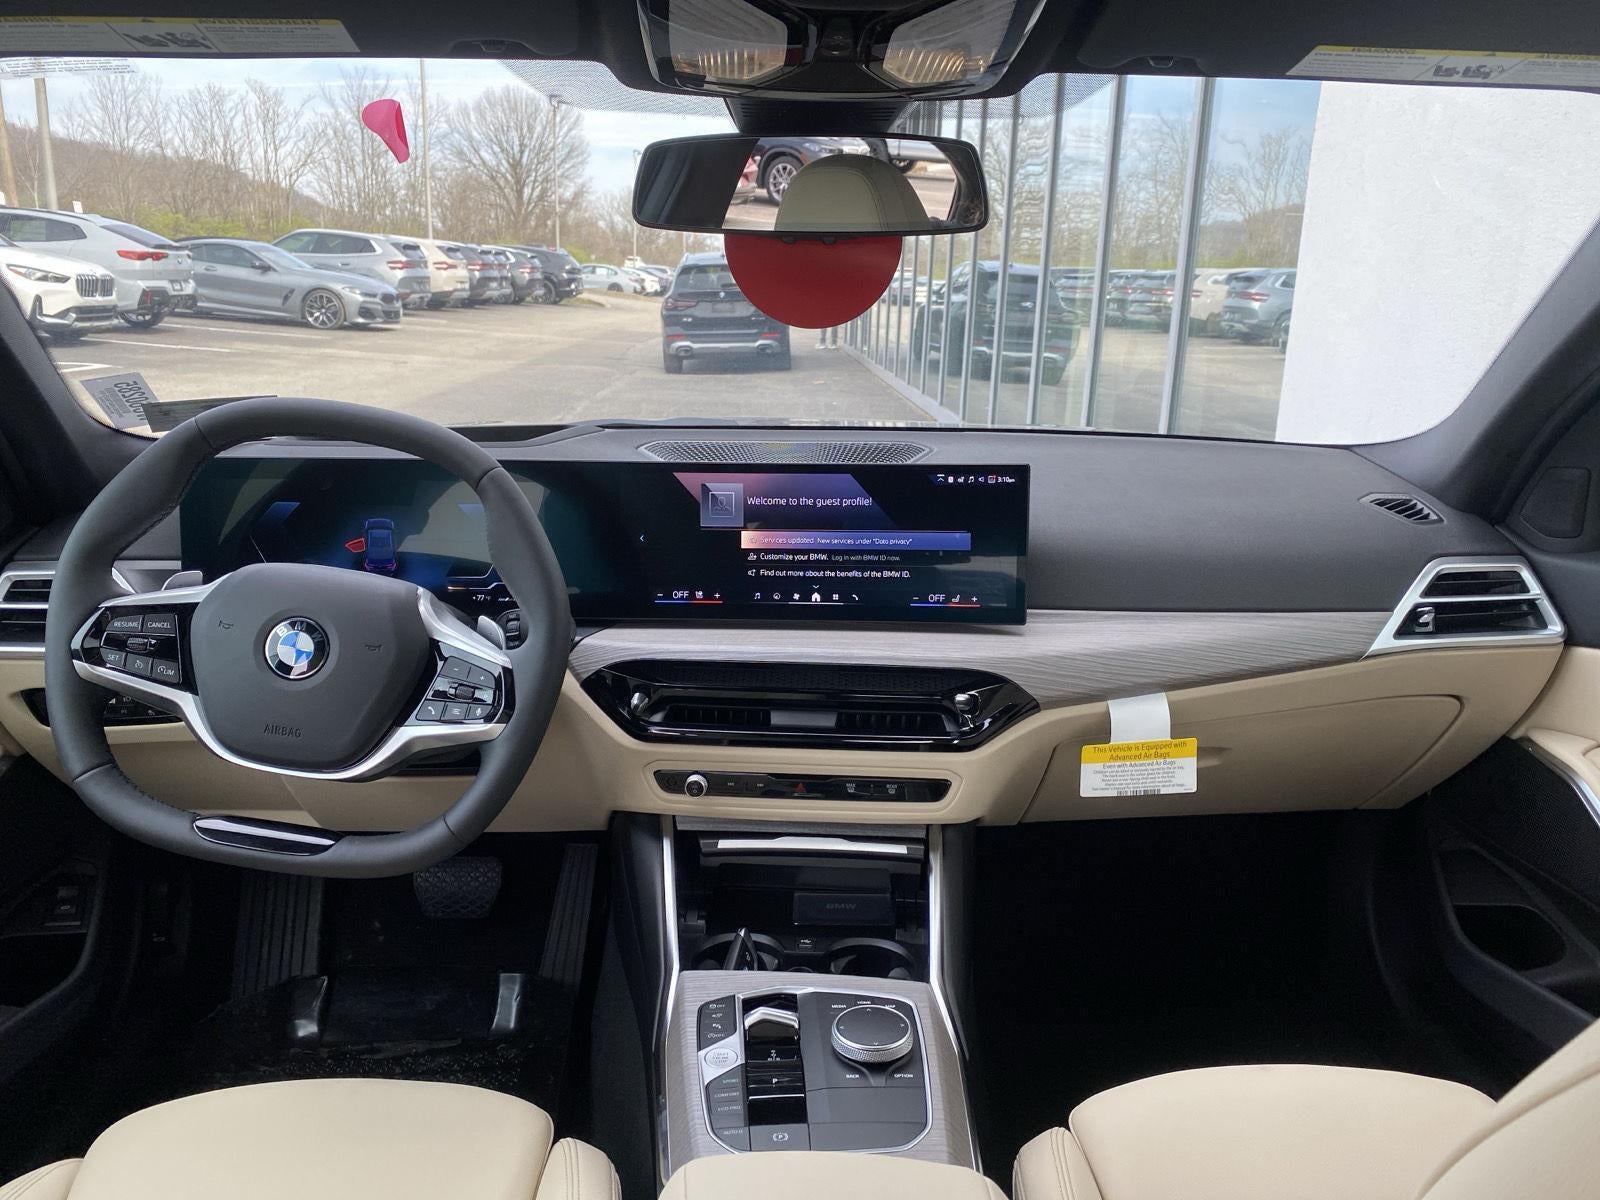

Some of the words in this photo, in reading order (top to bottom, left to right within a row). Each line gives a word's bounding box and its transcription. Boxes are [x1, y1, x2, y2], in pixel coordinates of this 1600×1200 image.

[746, 496, 787, 505] Welcome
[788, 497, 798, 505] to
[799, 497, 814, 505] the
[815, 497, 841, 507] guest
[842, 497, 873, 507] profile!
[759, 552, 794, 561] Customize
[794, 553, 809, 562] your
[809, 553, 829, 561] BMW.
[759, 569, 775, 577] Find
[836, 570, 863, 578] benefits
[862, 570, 871, 578] of
[672, 590, 689, 599] OFF
[928, 594, 946, 602] OFF
[263, 723, 302, 738] AIRBAG
[1108, 744, 1133, 752] Vehicle
[1141, 743, 1173, 751] Equipped
[1109, 753, 1142, 761] Advanced
[1153, 751, 1170, 759] Bags
